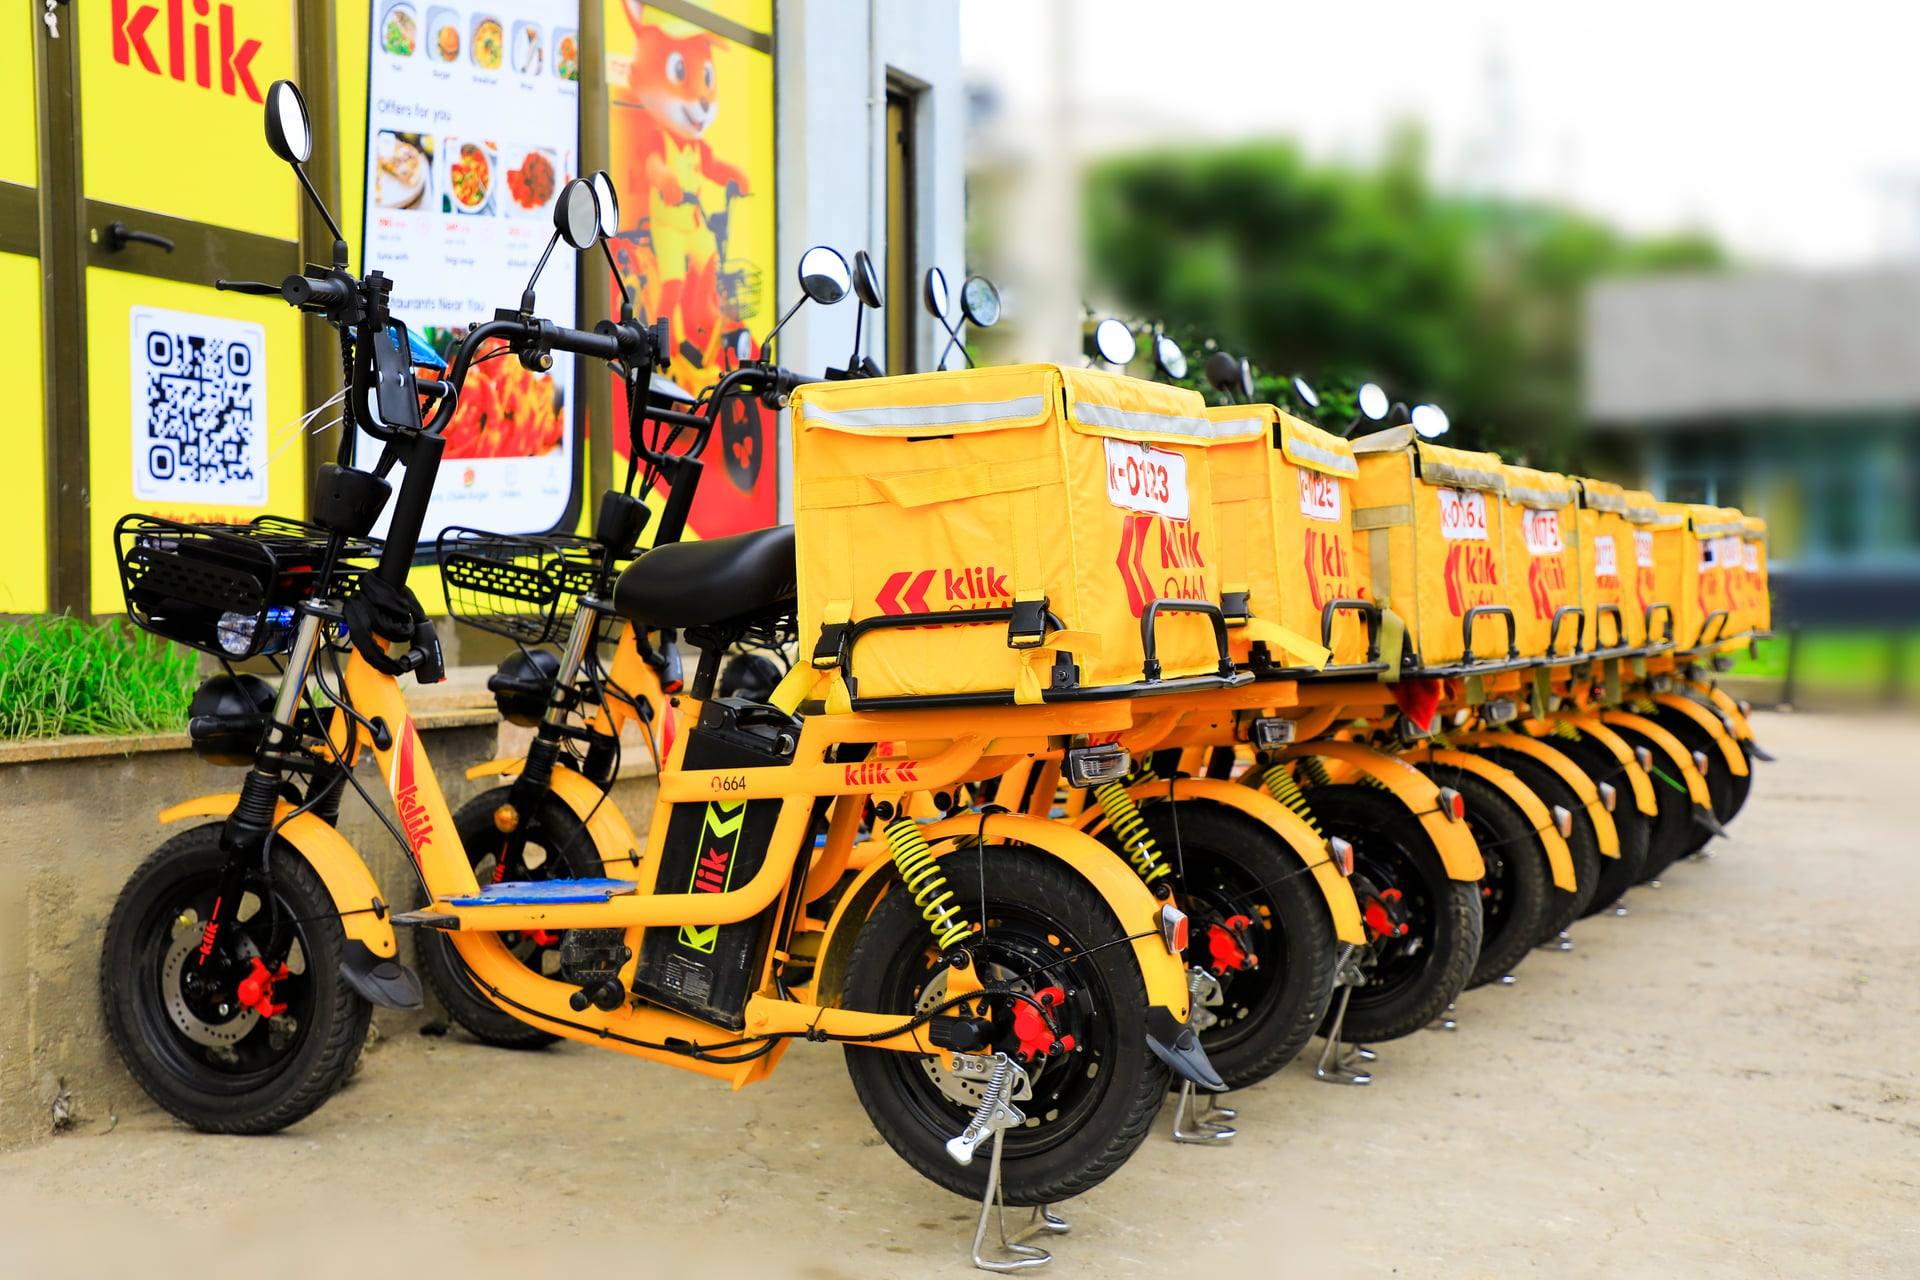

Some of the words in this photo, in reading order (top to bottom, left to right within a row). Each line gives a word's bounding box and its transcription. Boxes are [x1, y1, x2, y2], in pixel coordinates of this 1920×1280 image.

[111, 0, 264, 104] klik
[944, 566, 1011, 601] klik
[723, 775, 747, 791] 664
[844, 761, 892, 786] klik
[396, 785, 434, 850] klik
[694, 847, 730, 894] lik
